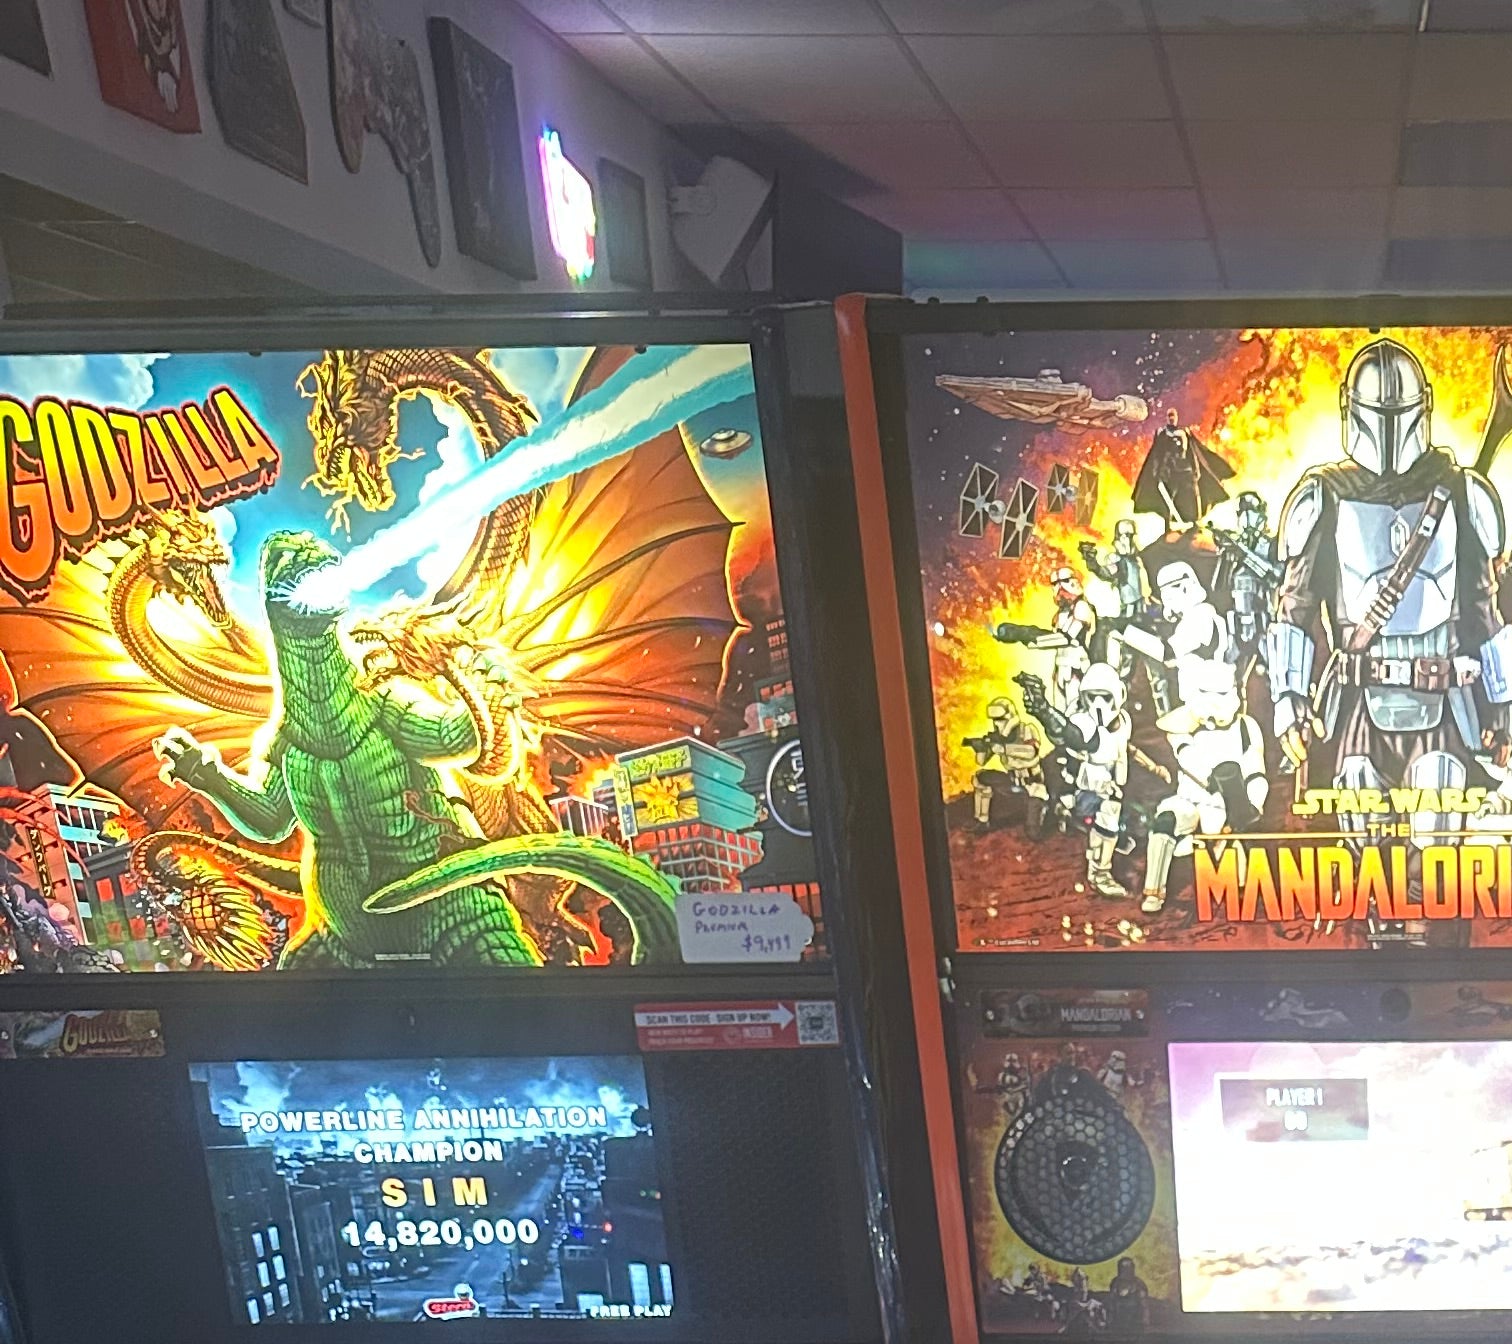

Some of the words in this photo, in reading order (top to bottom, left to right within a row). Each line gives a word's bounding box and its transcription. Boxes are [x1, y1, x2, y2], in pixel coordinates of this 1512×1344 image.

[0, 388, 280, 585] GODZILLA
[1292, 787, 1391, 814] STAR
[1390, 787, 1487, 814] WARS
[1366, 823, 1410, 837] THE
[692, 902, 780, 916] GODZILLA
[646, 1015, 668, 1025] SCAN
[670, 1015, 689, 1024] THIS
[689, 1014, 711, 1024] CODE
[716, 1014, 735, 1023] SIGN
[737, 1013, 748, 1022] UP
[1266, 1087, 1315, 1107] PLAYER
[241, 1108, 403, 1133] POWERLINE
[414, 1106, 607, 1131] ANNIHILATION
[354, 1140, 503, 1164] CHAMPION
[344, 1218, 539, 1252] 14,820,000
[633, 1303, 673, 1317] PLAY
